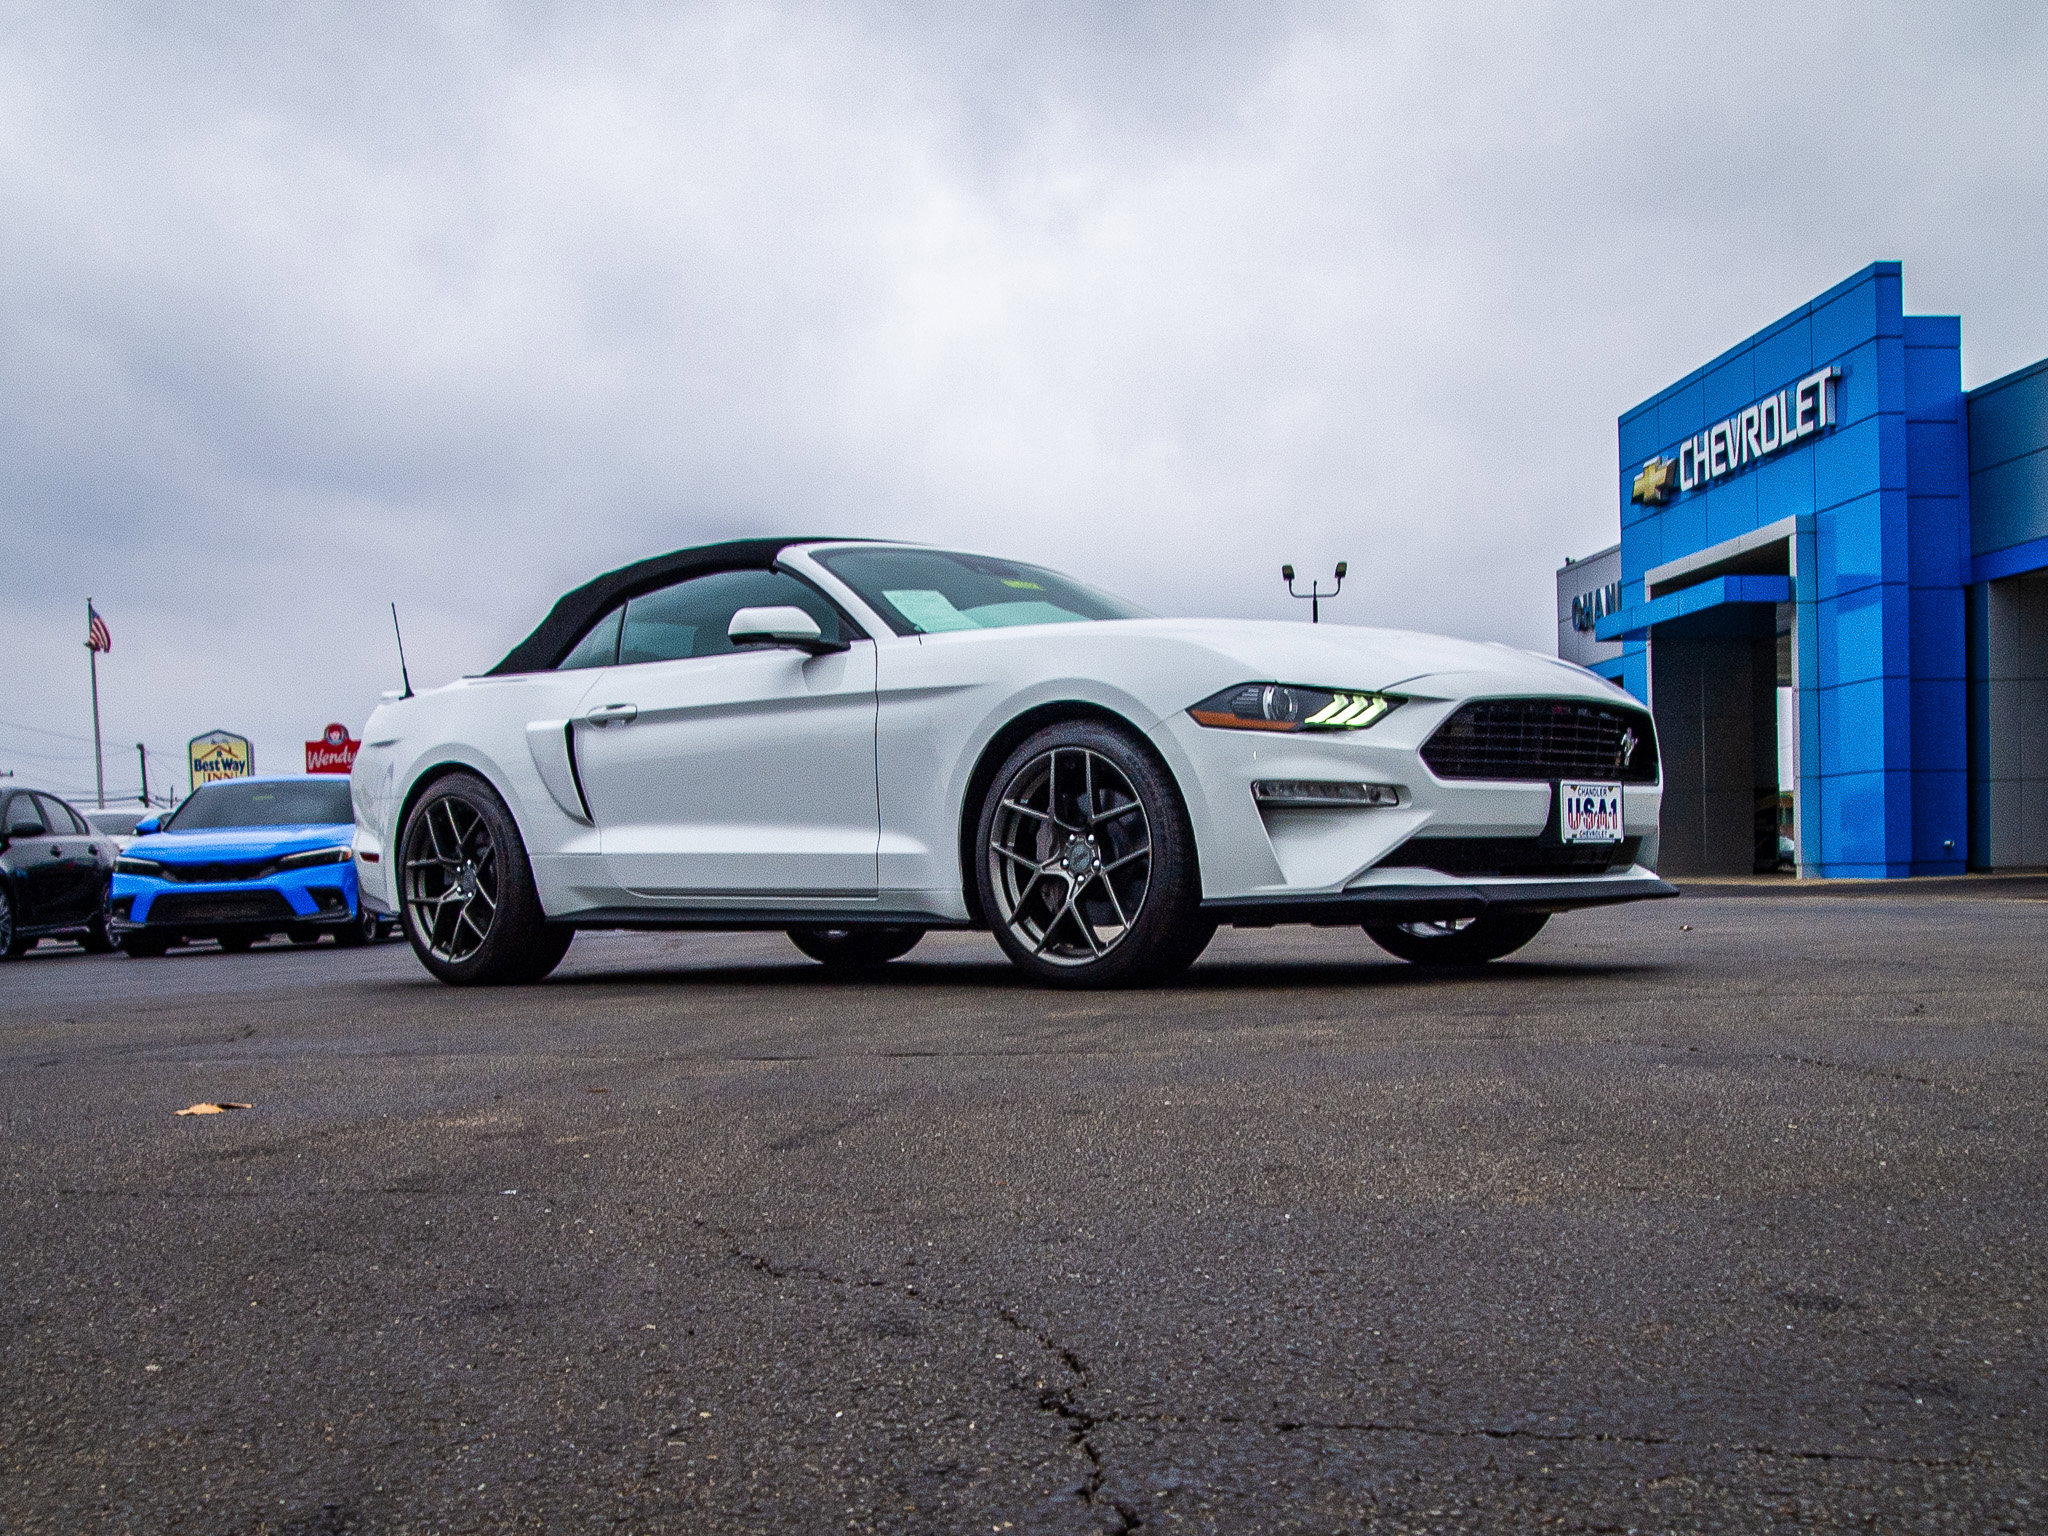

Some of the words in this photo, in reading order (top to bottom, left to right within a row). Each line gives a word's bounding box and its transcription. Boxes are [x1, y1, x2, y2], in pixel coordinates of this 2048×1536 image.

[1679, 366, 1837, 492] CHEVROLET
[307, 745, 357, 770] Wendy
[194, 758, 220, 772] Best
[221, 757, 245, 774] Way
[207, 772, 234, 782] INN
[1578, 786, 1608, 797] CHANDLER
[1579, 829, 1608, 838] CHEVROLET
